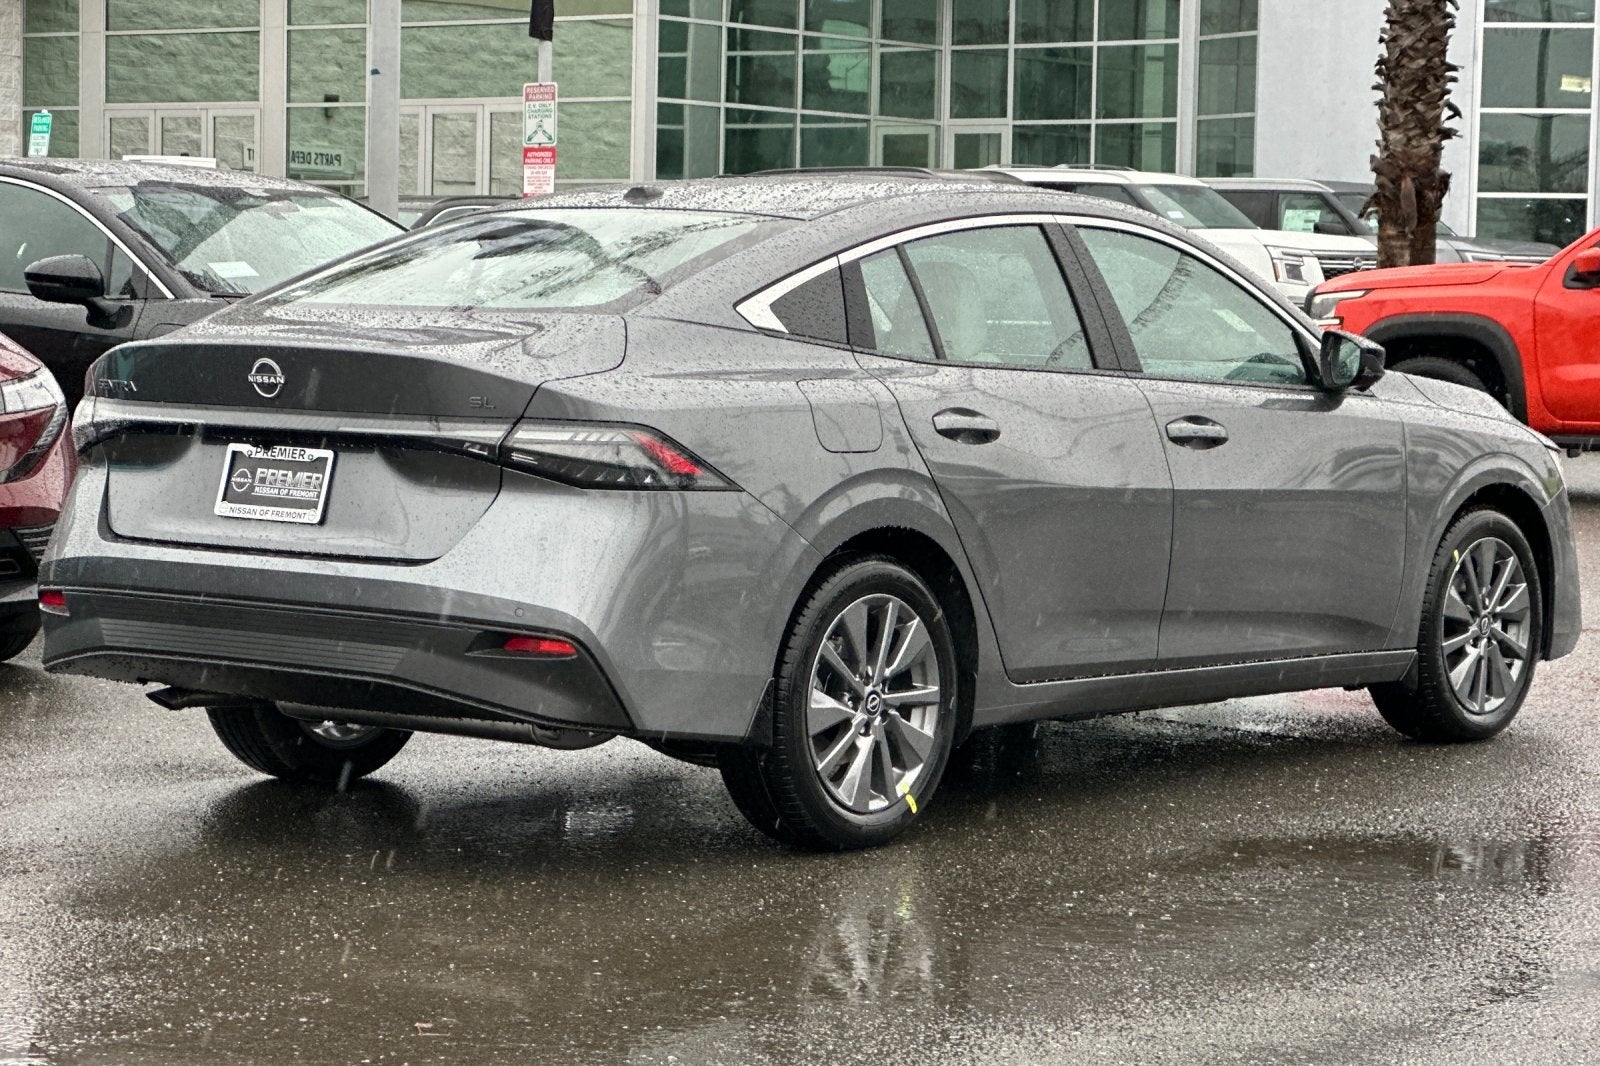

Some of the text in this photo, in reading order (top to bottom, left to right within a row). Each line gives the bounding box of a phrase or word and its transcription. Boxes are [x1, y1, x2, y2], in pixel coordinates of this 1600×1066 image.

[526, 86, 555, 94] RESERVED
[248, 375, 285, 384] NISSAN
[469, 396, 495, 408] SL
[254, 445, 307, 460] PREMIER
[254, 467, 323, 490] PREMIER
[254, 486, 278, 495] NISSAN
[289, 490, 319, 498] FREMONT
[228, 506, 307, 520] NISSAN OF FREMONT
